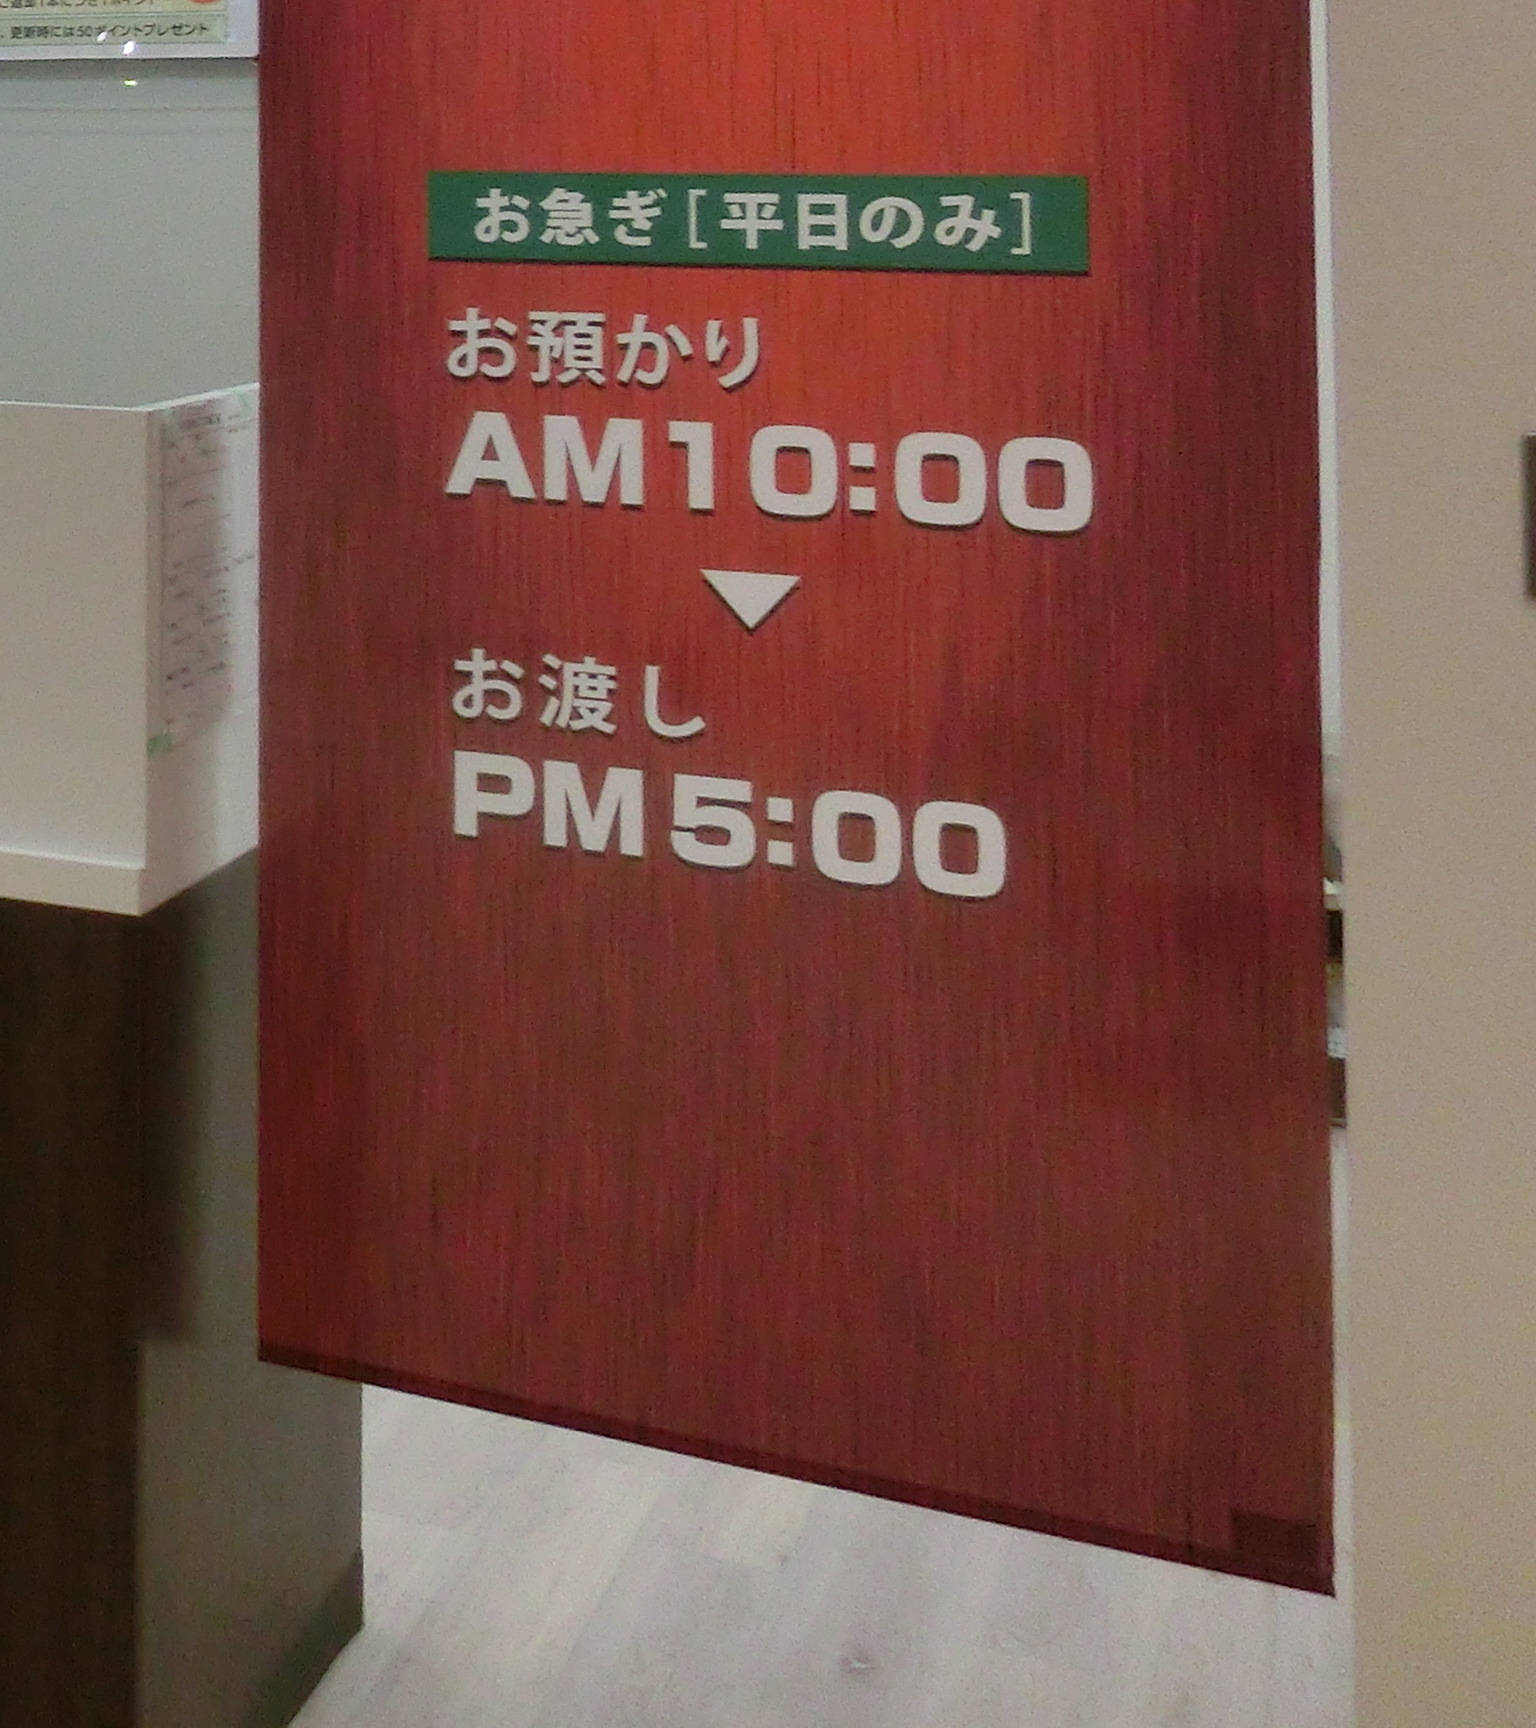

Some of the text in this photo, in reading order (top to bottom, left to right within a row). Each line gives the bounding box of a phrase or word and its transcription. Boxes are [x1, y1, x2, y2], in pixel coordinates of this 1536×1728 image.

[446, 307, 761, 391] お預かり
[444, 411, 1094, 535] AM10:00
[449, 647, 706, 740] お渡し
[449, 749, 1008, 901] PM5:00
